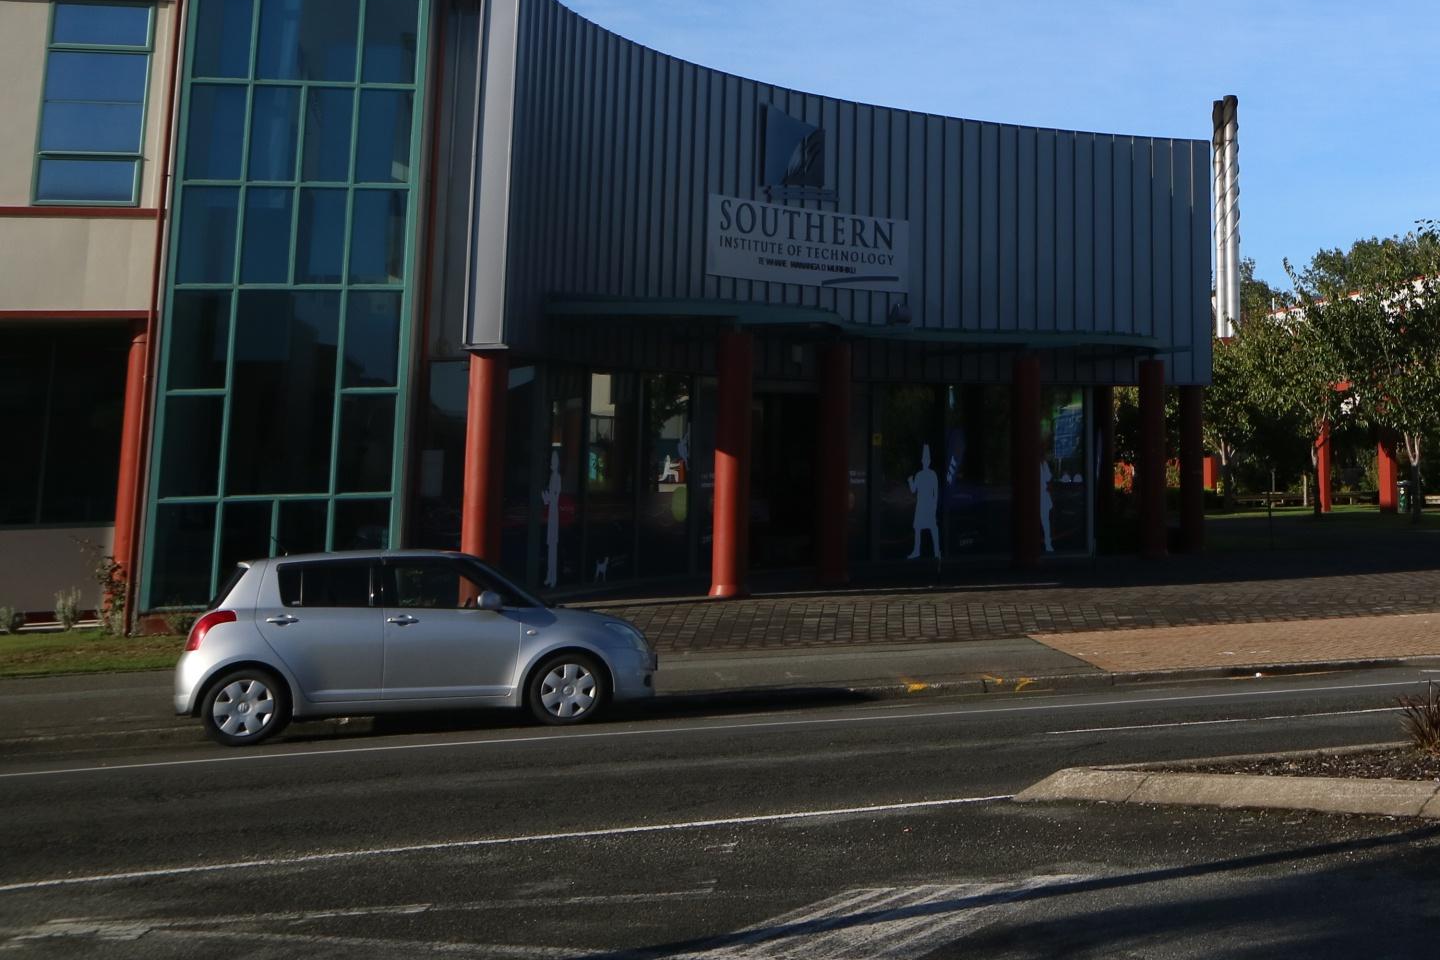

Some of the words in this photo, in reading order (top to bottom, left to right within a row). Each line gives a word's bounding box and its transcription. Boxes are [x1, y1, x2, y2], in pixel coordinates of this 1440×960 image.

[720, 199, 895, 250] SOUTHERN
[719, 235, 783, 255] INSTITUTE
[787, 244, 802, 256] OF
[806, 246, 895, 266] TECHNOLOGY
